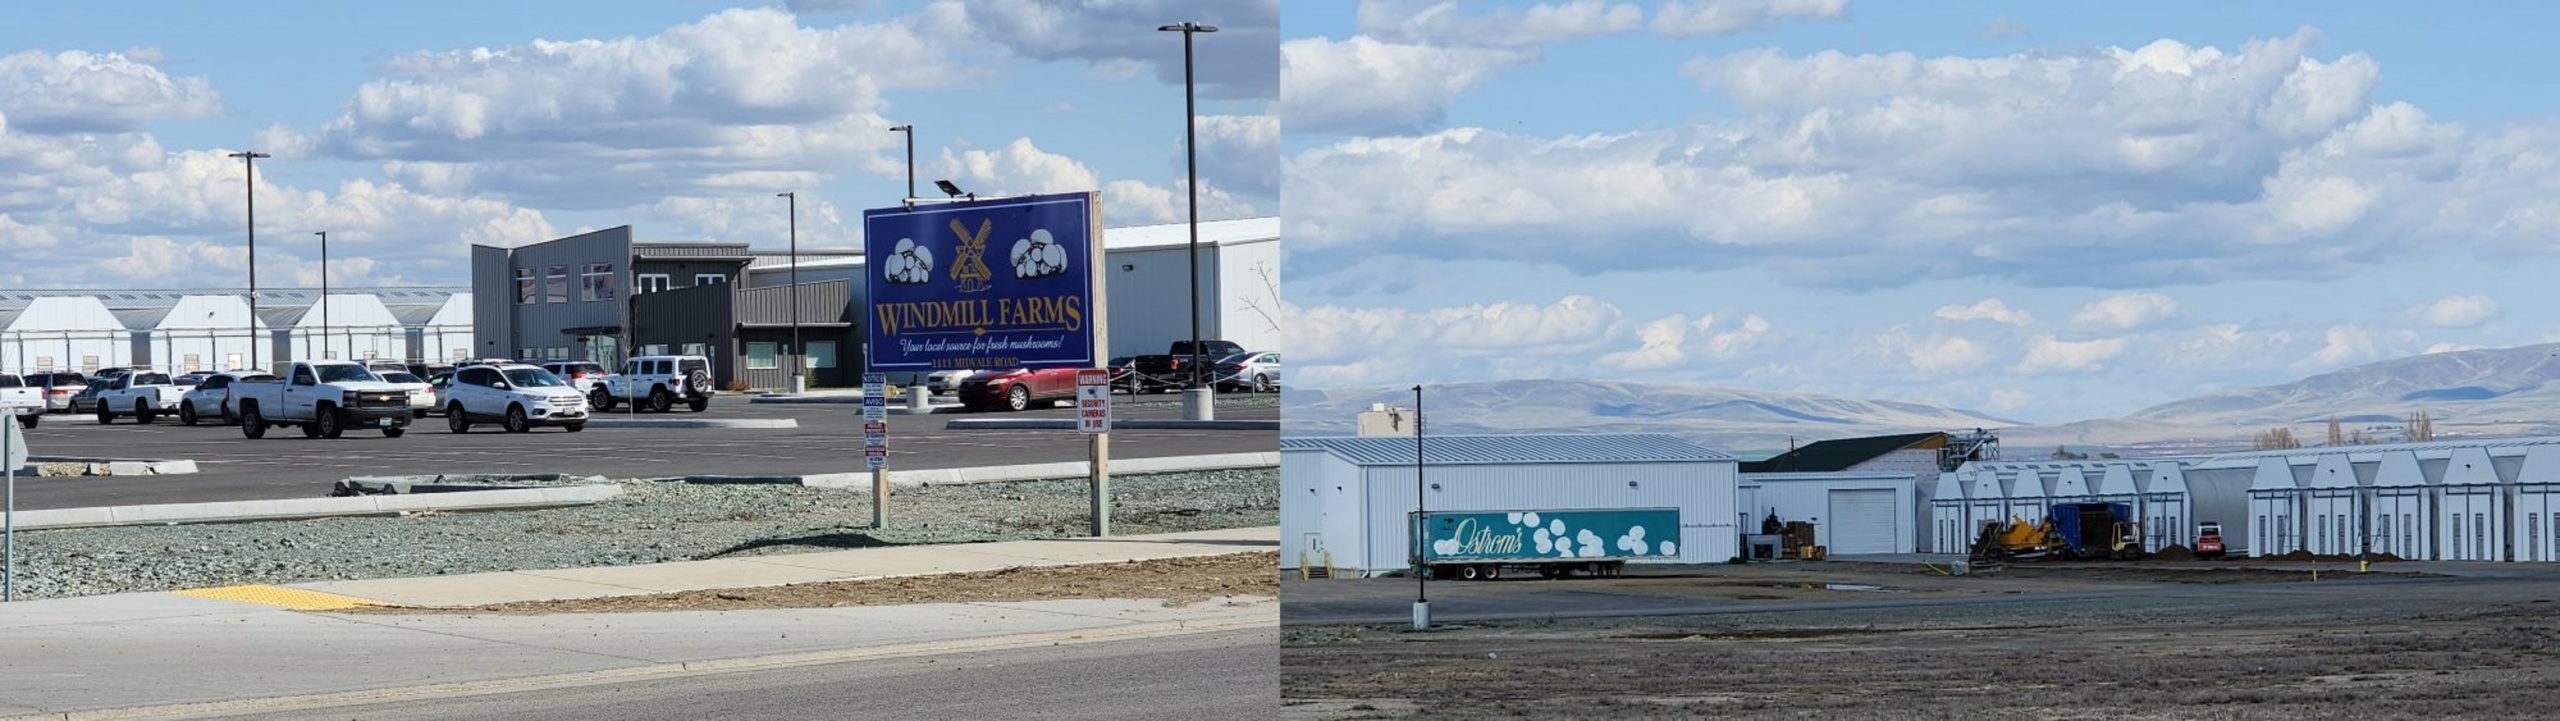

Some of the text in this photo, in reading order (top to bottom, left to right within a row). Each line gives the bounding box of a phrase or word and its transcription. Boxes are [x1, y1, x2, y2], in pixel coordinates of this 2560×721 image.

[876, 295, 1081, 337] WINDMILL FARMS
[899, 334, 1065, 356] Your local source for fresh mushrooms!
[932, 356, 1019, 368] 1111 MIDVALE ROAD
[864, 374, 884, 382] NOTICE
[1079, 373, 1106, 385] WARNING
[865, 398, 883, 406] AVISO
[1081, 399, 1105, 408] SECURITY
[1081, 409, 1106, 418] CAMERAS
[1092, 419, 1103, 428] USE
[1454, 517, 1522, 555] Ostrom's
